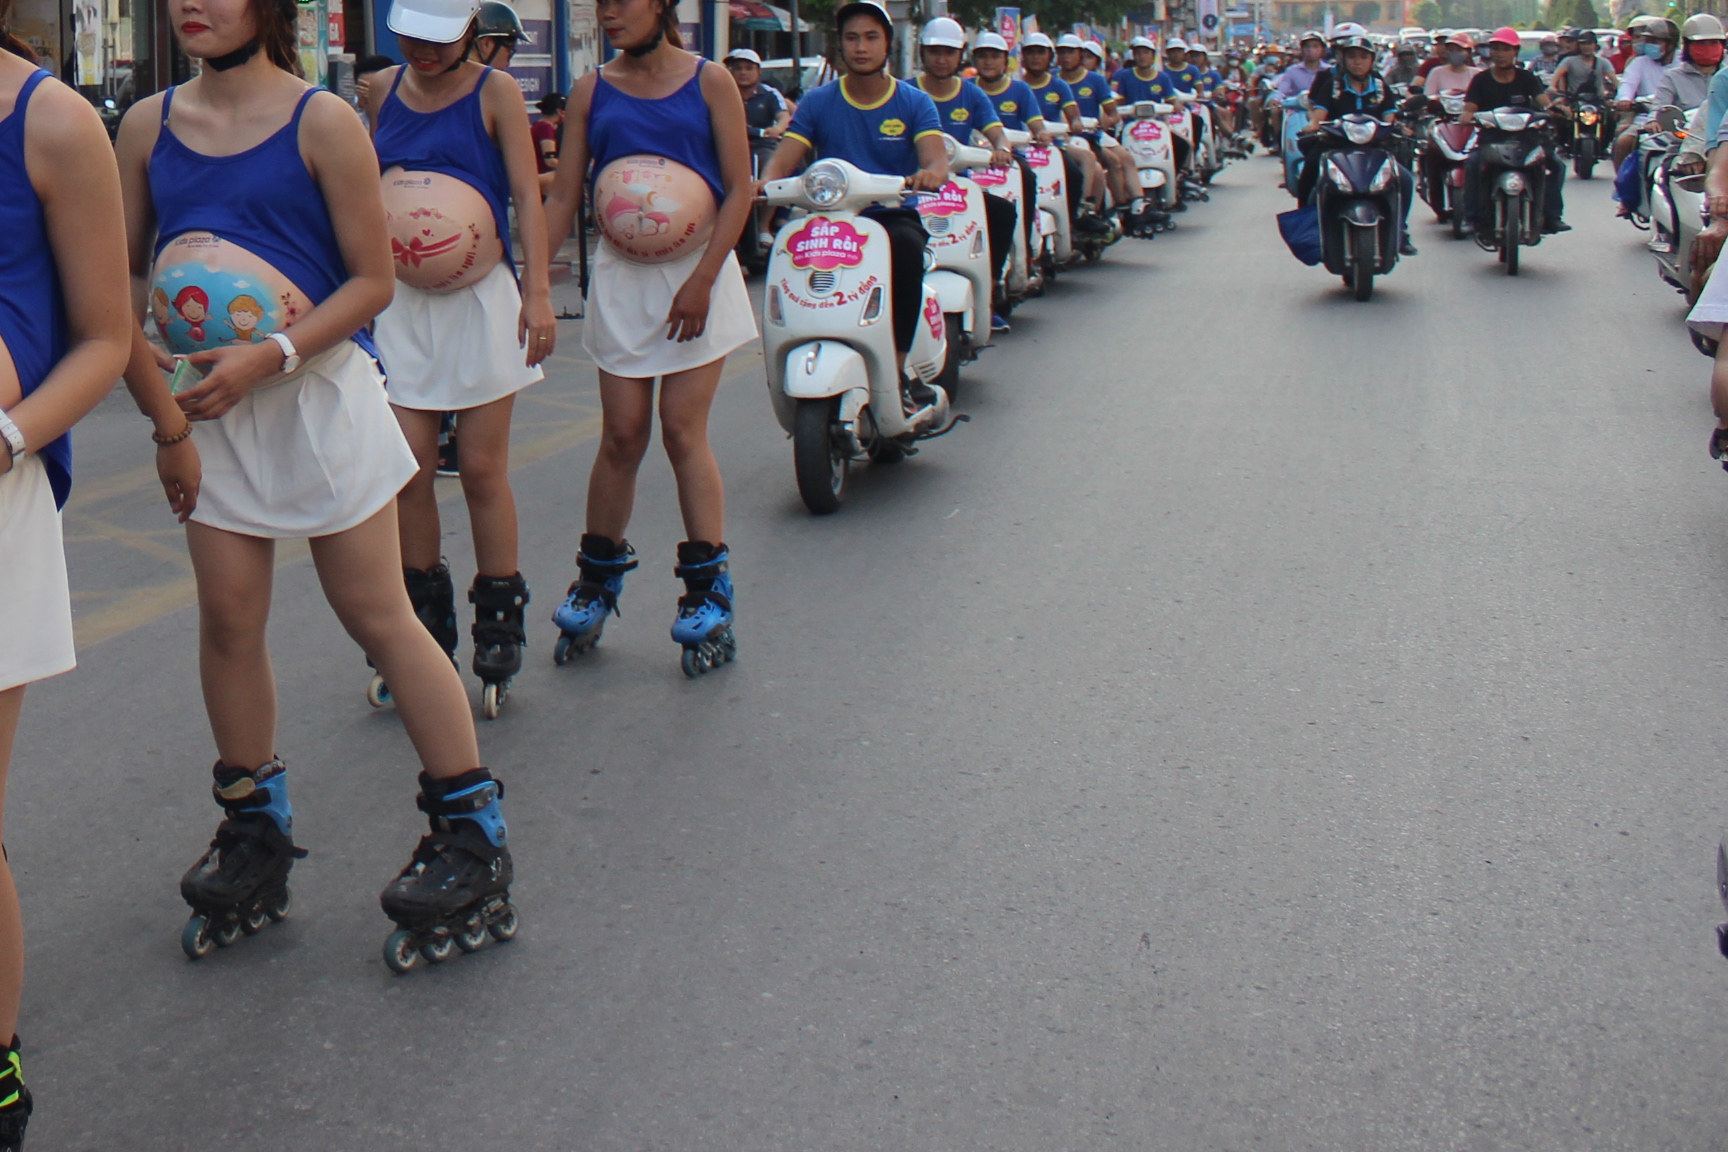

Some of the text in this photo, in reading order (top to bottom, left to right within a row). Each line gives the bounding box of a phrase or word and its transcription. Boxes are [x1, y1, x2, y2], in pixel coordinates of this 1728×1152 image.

[796, 235, 858, 252] SINH RỒI
[947, 233, 959, 244] 2
[833, 292, 847, 306] 2
